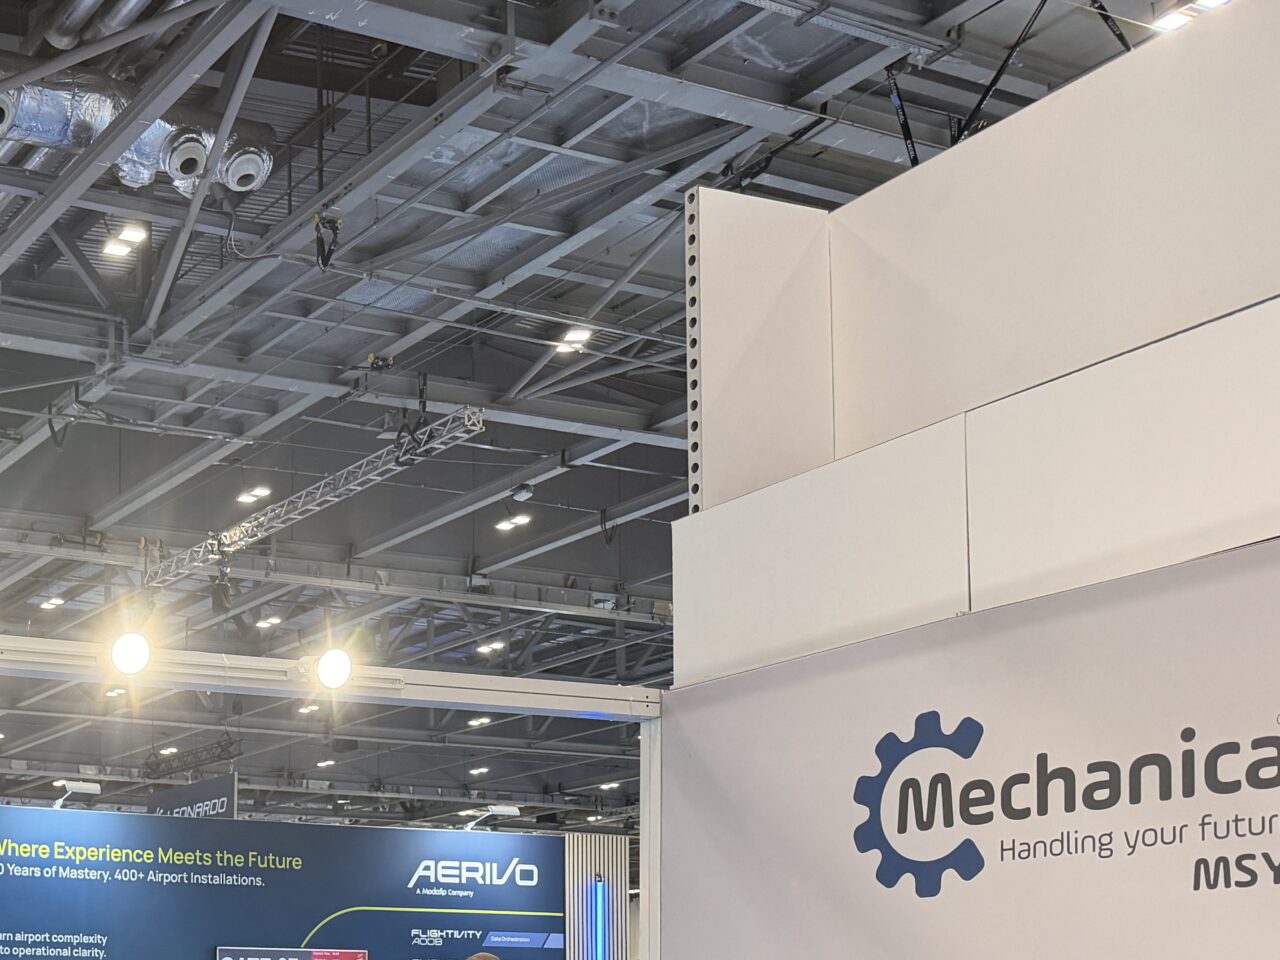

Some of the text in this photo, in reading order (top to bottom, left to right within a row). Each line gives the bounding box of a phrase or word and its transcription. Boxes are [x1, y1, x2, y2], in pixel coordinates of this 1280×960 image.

[1000, 830, 1114, 861] Handling
[1124, 824, 1189, 855] your
[53, 841, 154, 865] Experience
[158, 847, 212, 866] Meets
[215, 850, 245, 868] the
[248, 851, 303, 870] Future
[7, 863, 42, 878] Years
[43, 865, 57, 878] of
[58, 865, 112, 884] Mastery.
[114, 868, 145, 882] 400+
[147, 870, 188, 886] Airport
[190, 872, 266, 887] Installations.
[407, 857, 539, 889] AERIVO
[448, 888, 474, 898] Company
[15, 931, 51, 945] airport
[52, 933, 108, 947] complexity
[411, 928, 483, 939] FLIGHTIVITY
[12, 945, 71, 958] operational
[73, 946, 107, 960] clarity.
